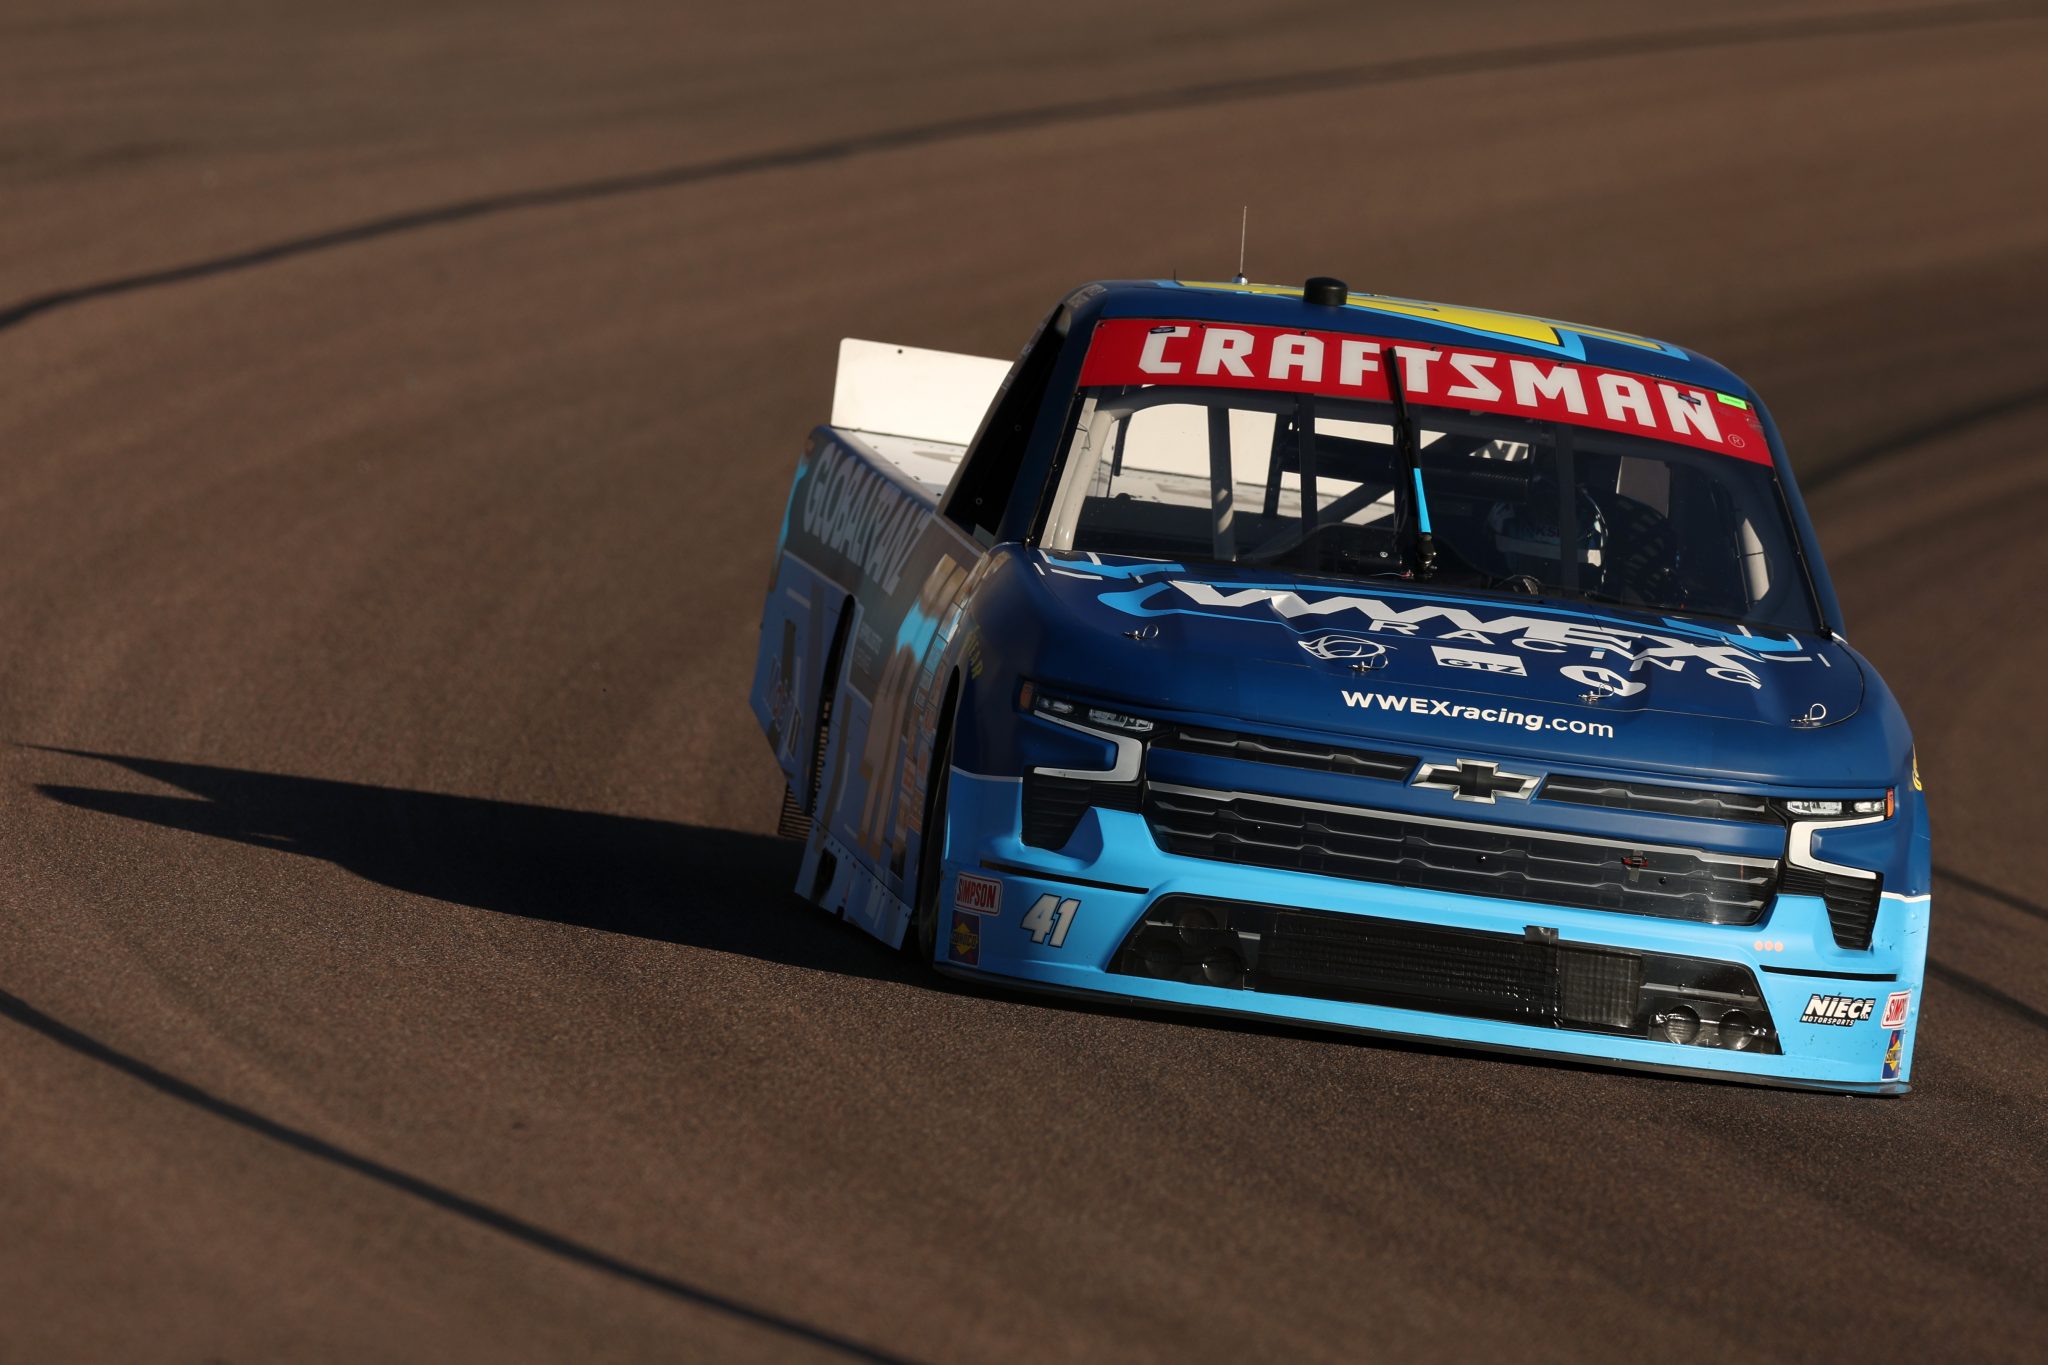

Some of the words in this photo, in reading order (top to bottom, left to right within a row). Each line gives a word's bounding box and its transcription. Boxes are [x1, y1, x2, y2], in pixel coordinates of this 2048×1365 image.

[1138, 326, 1723, 444] CRAFTSMAN
[1368, 618, 1763, 690] RACING
[1341, 690, 1614, 739] WWEXracing.com
[957, 878, 997, 909] SIMPSON
[1020, 893, 1082, 949] 41
[1801, 1015, 1855, 1027] MOTORSPORTS
